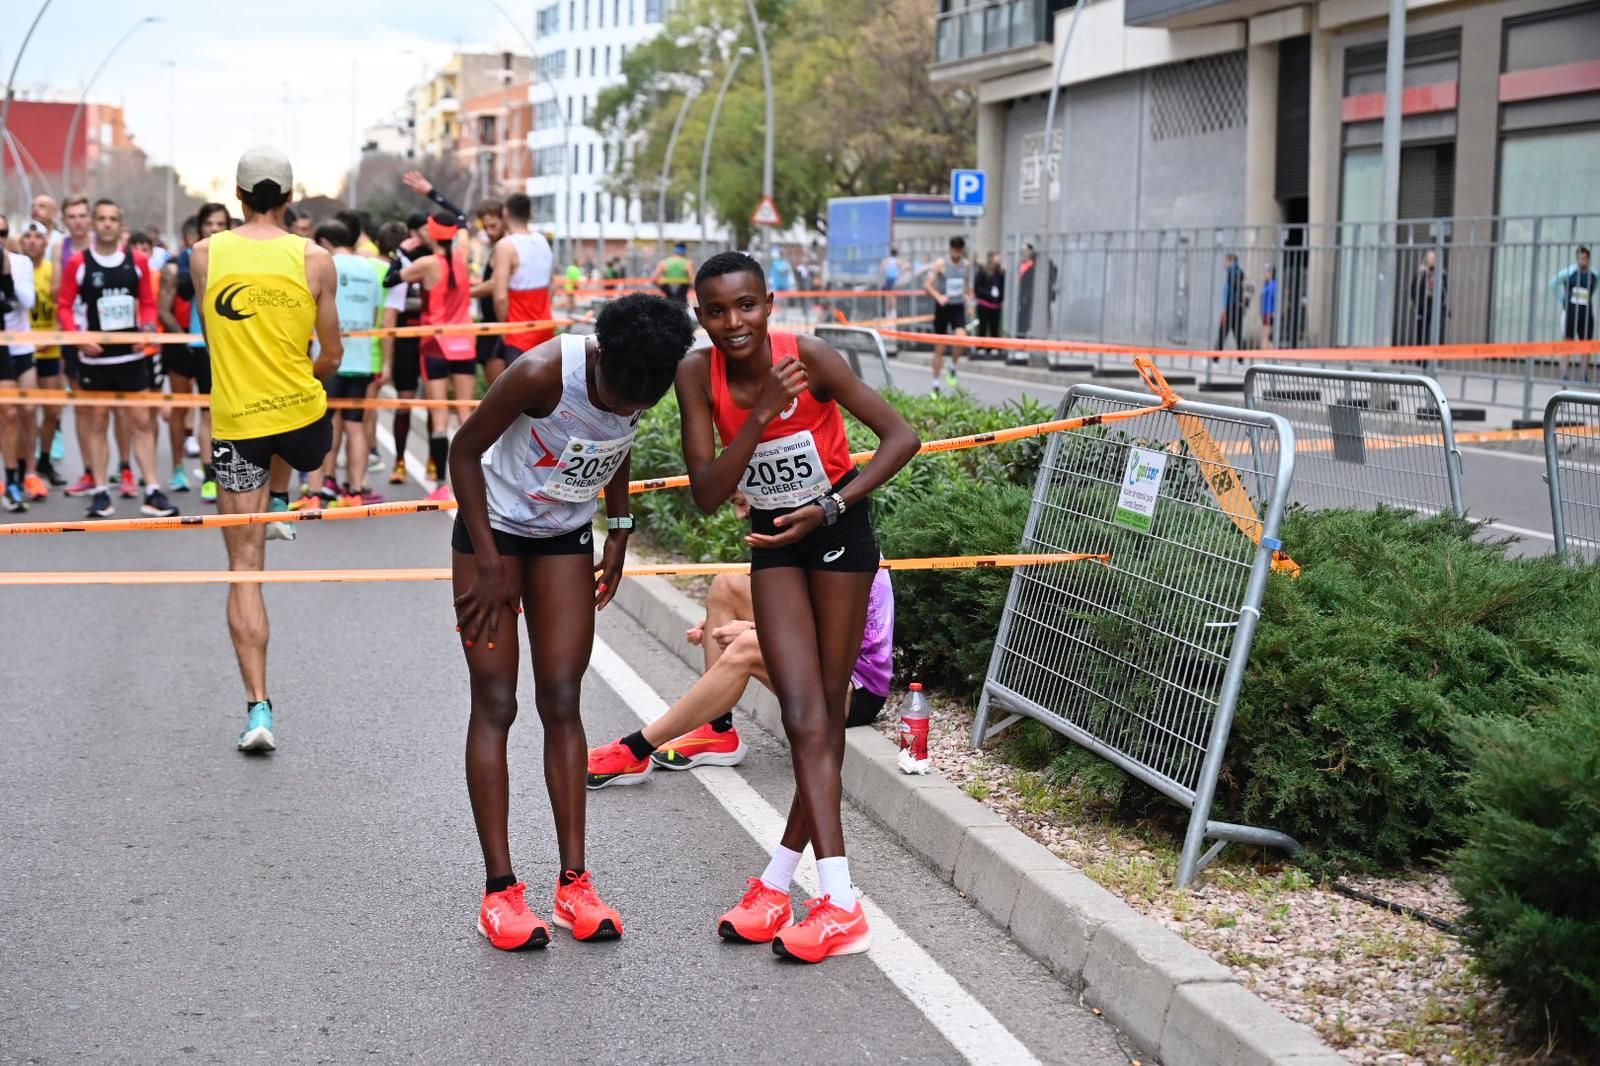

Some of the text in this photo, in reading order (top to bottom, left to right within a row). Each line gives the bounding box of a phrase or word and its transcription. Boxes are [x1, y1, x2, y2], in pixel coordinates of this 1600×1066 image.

[958, 175, 980, 201] P
[248, 297, 302, 308] MENORCA
[562, 450, 623, 479] 2059
[746, 453, 813, 488] 2055
[761, 480, 804, 496] CHEBET
